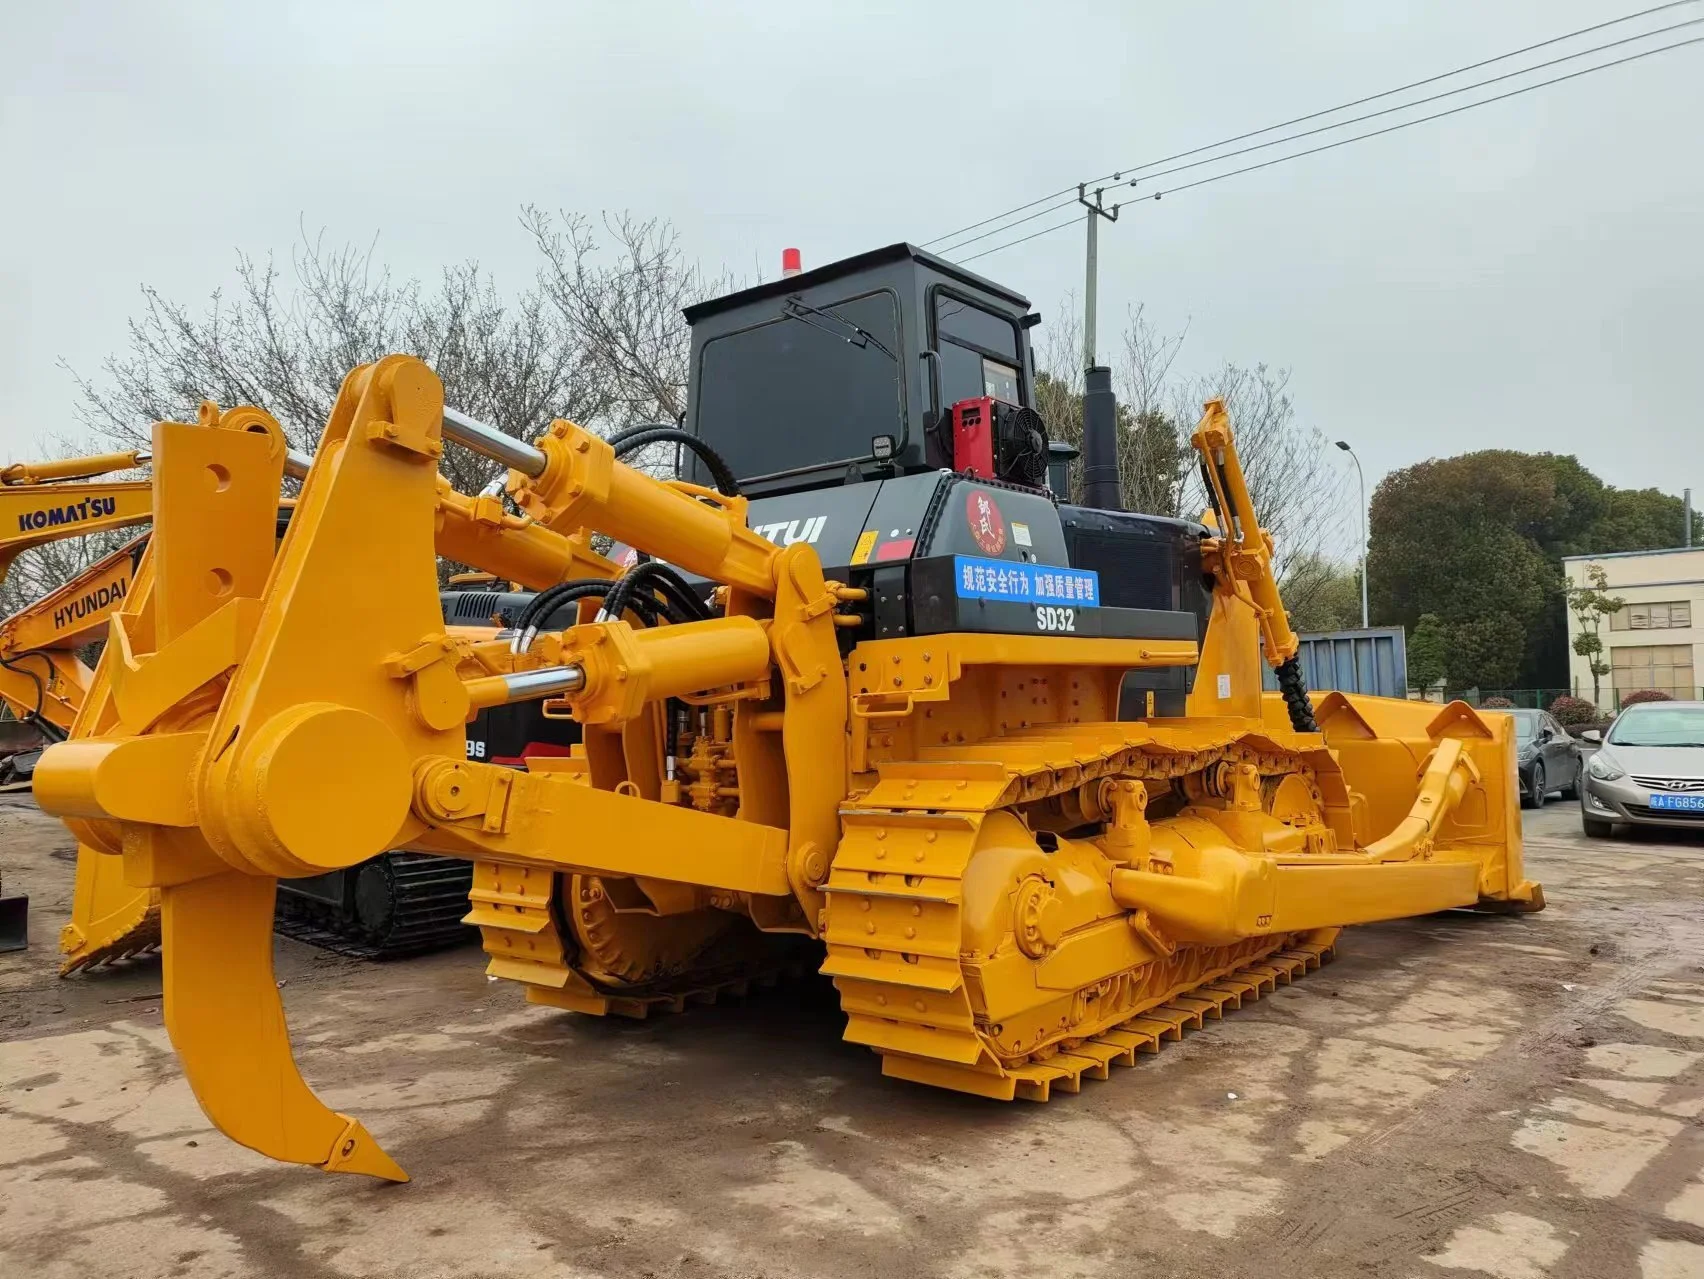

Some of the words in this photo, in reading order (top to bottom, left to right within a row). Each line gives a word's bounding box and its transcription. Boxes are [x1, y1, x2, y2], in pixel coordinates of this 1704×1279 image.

[18, 497, 116, 531] KOMATSU
[962, 564, 1029, 596] 规范安全行为
[1034, 571, 1095, 601] 加强质量管理
[54, 578, 127, 630] HYUNDAI
[1036, 606, 1076, 632] SD32
